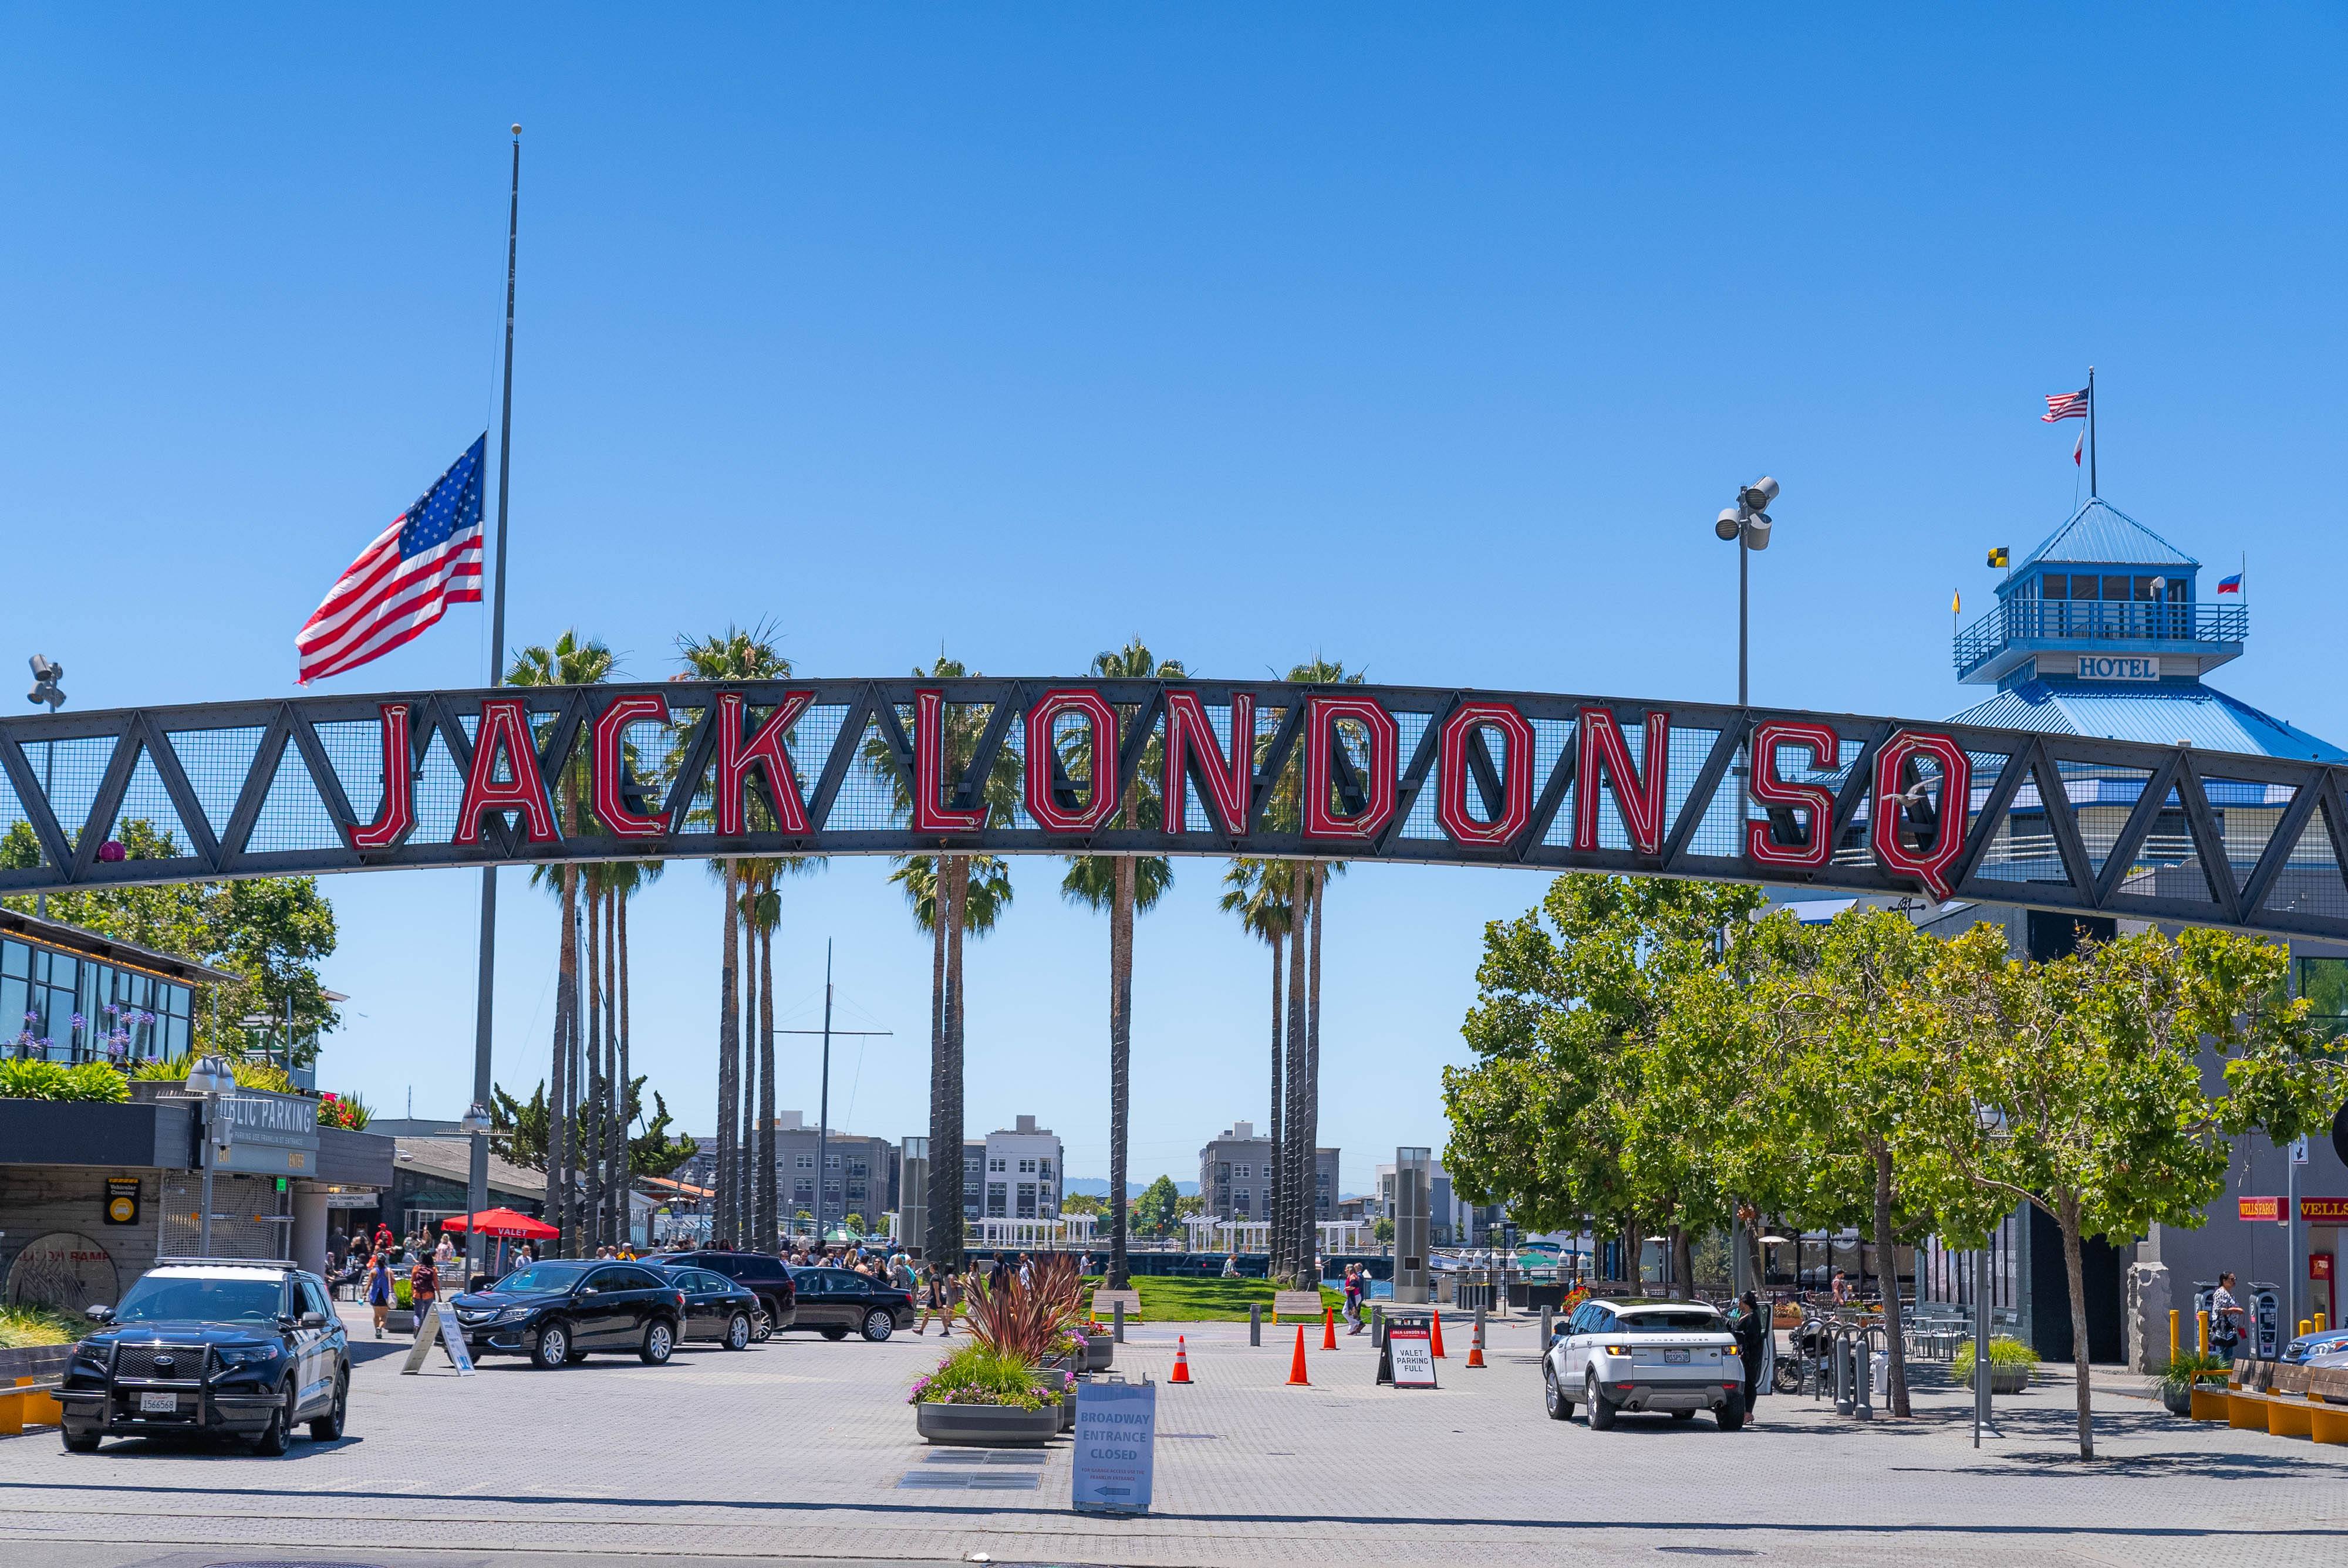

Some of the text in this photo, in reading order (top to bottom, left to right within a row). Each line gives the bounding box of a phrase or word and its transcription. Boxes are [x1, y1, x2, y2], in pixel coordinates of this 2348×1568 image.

[2079, 657, 2156, 678] HOTEL
[346, 688, 1971, 903] JACK LONDON SQ
[215, 1094, 310, 1133] UBLIC PARKING
[218, 1147, 231, 1163] EXIT
[288, 1153, 304, 1169] ENTER
[2240, 1203, 2276, 1215] WELLS FARGO
[498, 1228, 528, 1237] VALET
[143, 1400, 174, 1409] 1566568
[1081, 1412, 1151, 1425] BROADWAY
[1083, 1430, 1146, 1442] ENTRANCE
[1091, 1449, 1138, 1460] CLOSED
